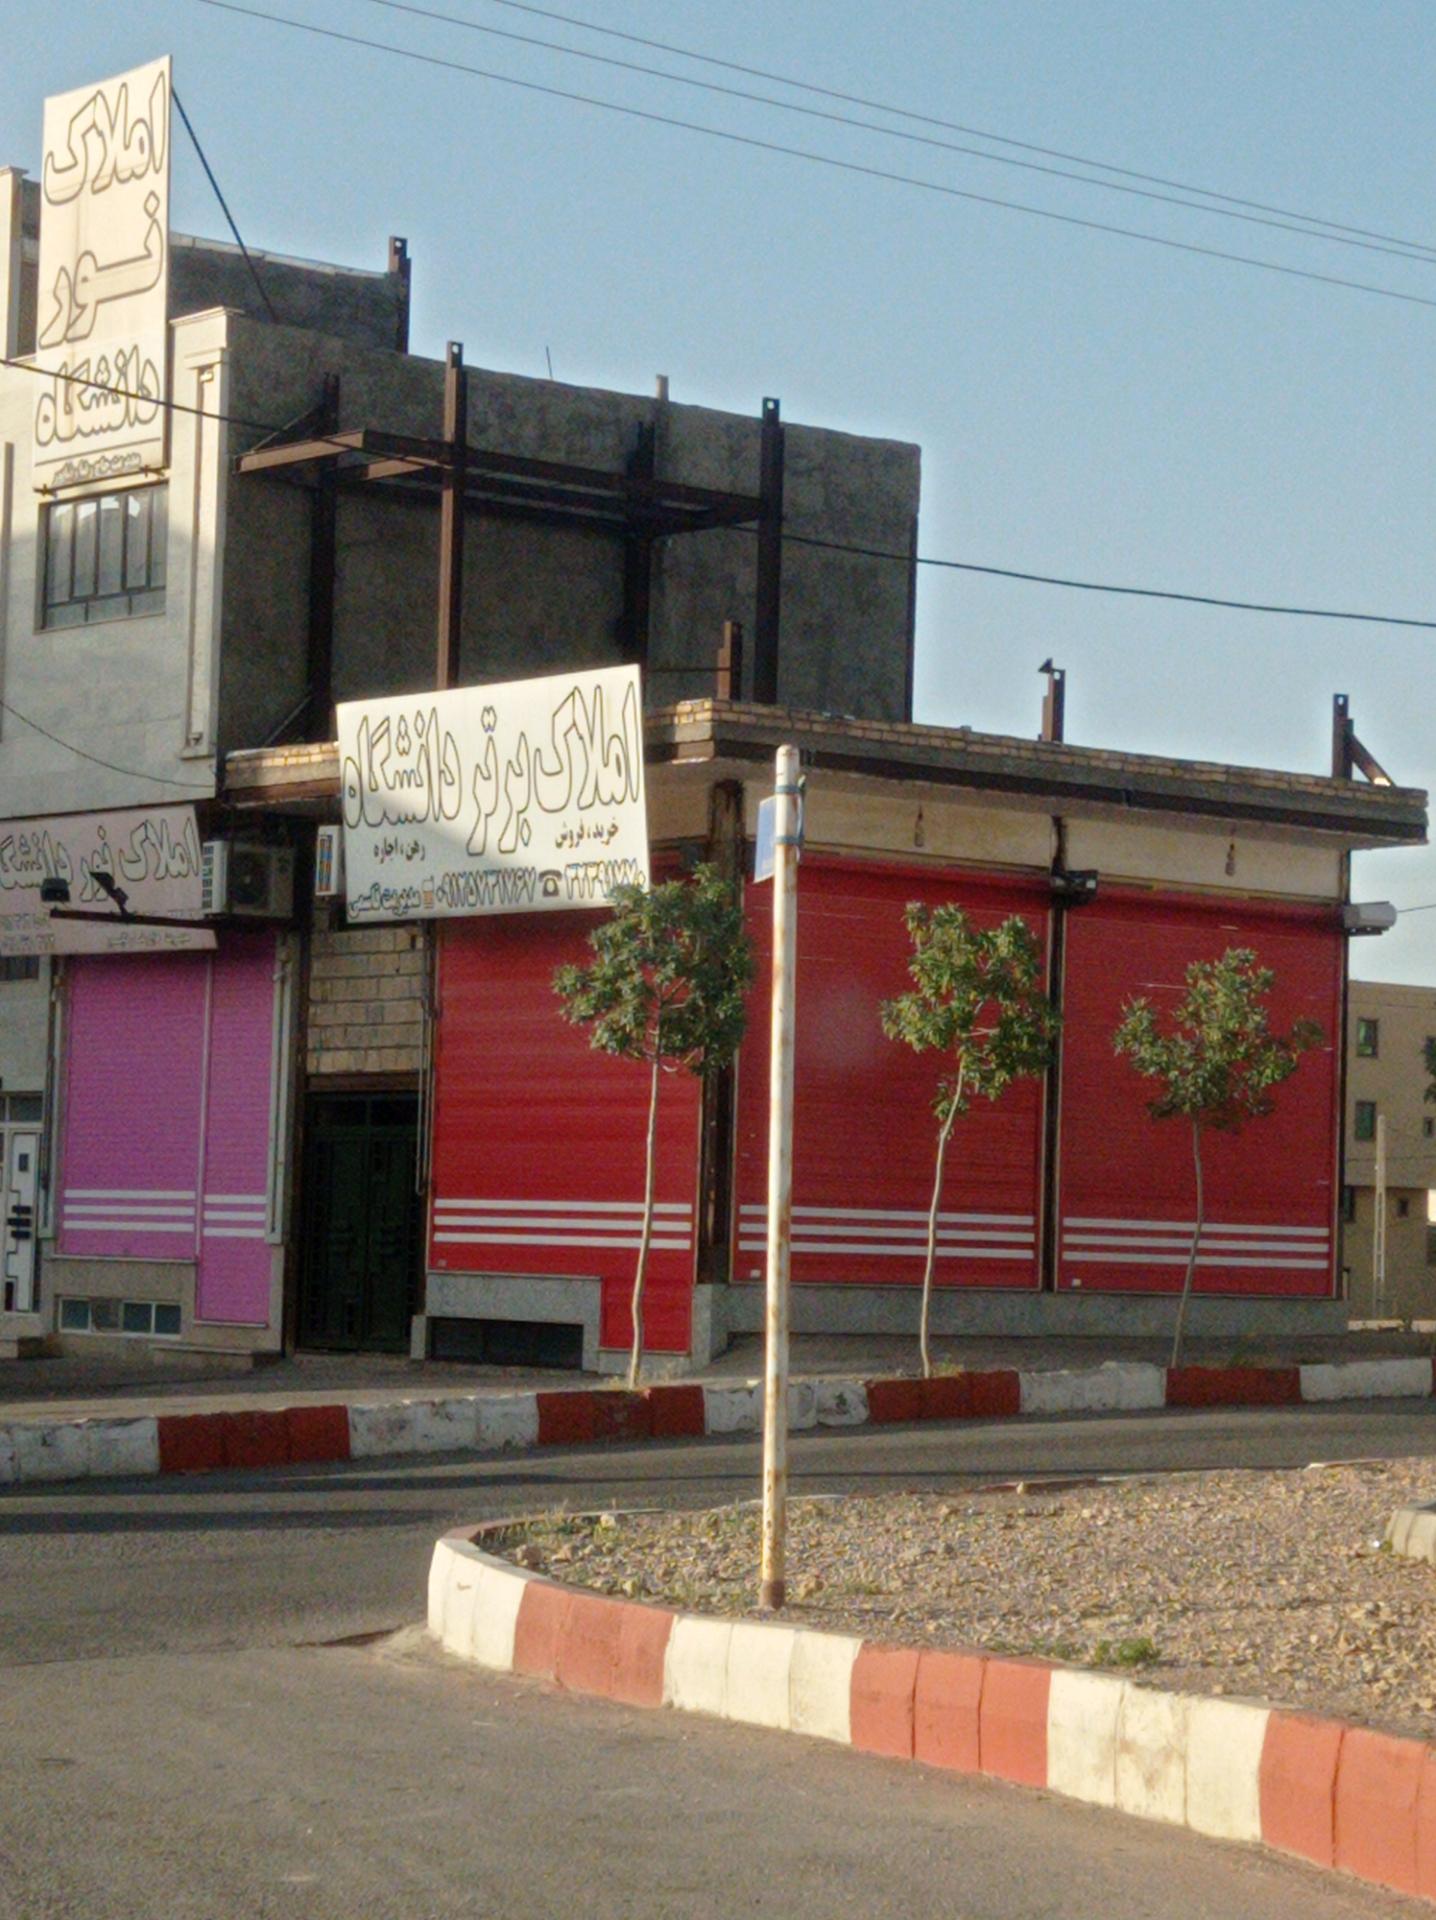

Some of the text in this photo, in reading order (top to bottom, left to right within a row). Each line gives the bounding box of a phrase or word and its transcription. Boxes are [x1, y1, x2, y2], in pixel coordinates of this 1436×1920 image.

[44, 70, 166, 206] املاک
[38, 189, 165, 351] نور
[35, 344, 161, 448] دانشگاه
[342, 680, 640, 856] املاک برتر دانشگاه
[119, 817, 199, 882] املاک
